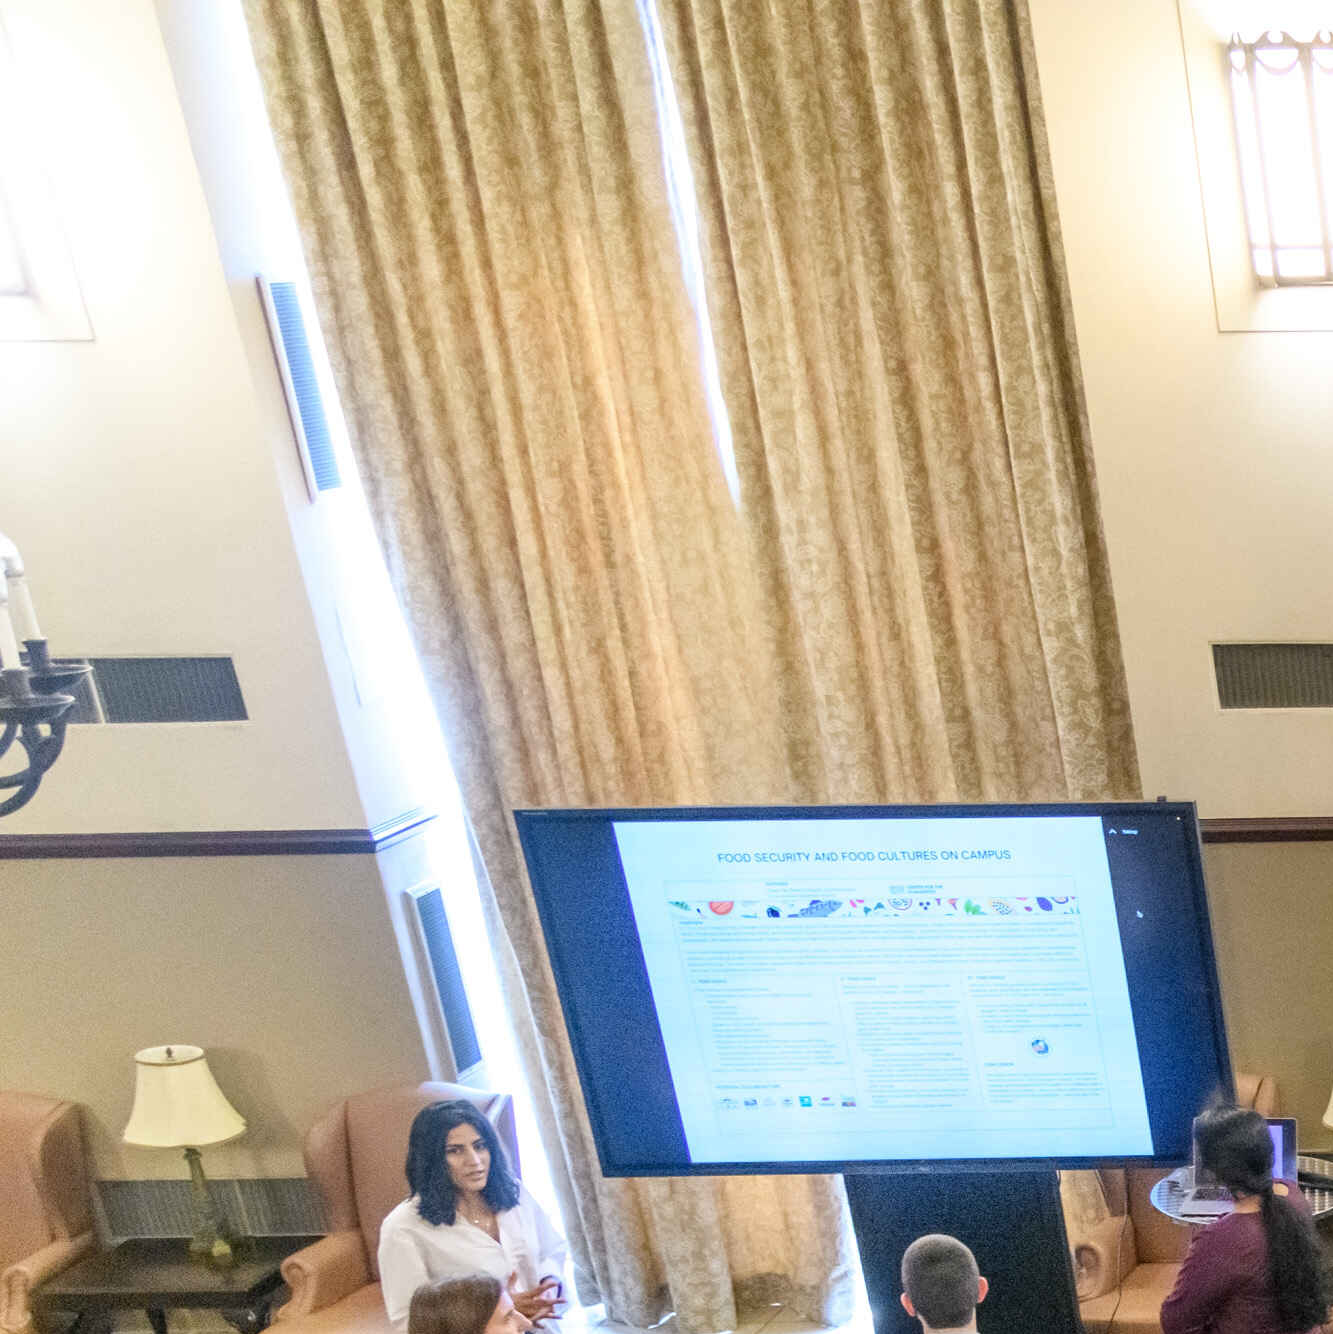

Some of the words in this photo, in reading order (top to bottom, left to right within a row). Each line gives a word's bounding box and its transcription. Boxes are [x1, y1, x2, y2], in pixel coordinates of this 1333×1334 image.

[717, 853, 751, 863] FOOD
[754, 852, 810, 862] SECURITY
[814, 852, 838, 862] AND
[842, 852, 875, 862] FOOD
[878, 850, 938, 861] CULTURES
[940, 850, 959, 860] ON
[961, 850, 1012, 860] CAMPUS
